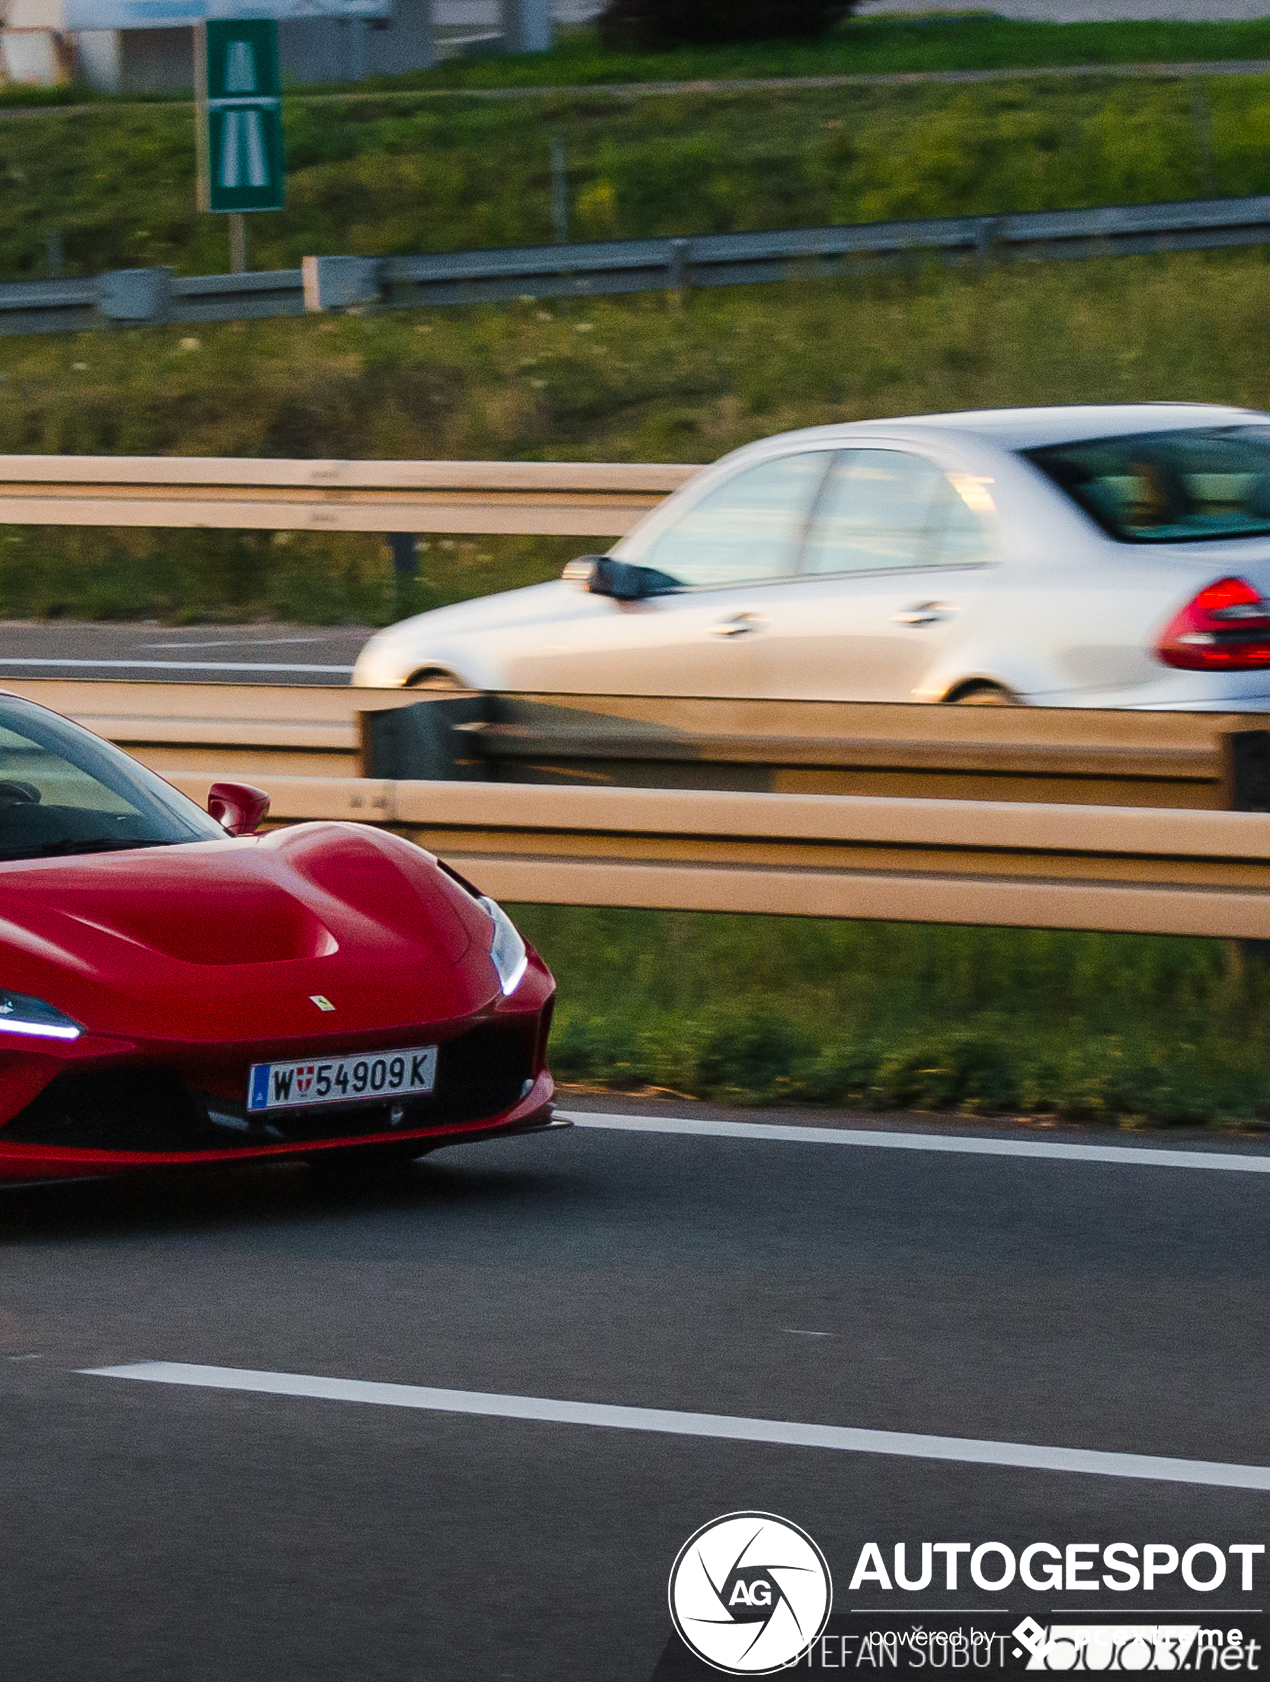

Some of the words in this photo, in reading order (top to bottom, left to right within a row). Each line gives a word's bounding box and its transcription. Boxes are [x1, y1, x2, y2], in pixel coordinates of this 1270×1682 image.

[274, 1069, 294, 1101] W
[316, 1057, 405, 1096] 54909
[411, 1054, 428, 1086] K
